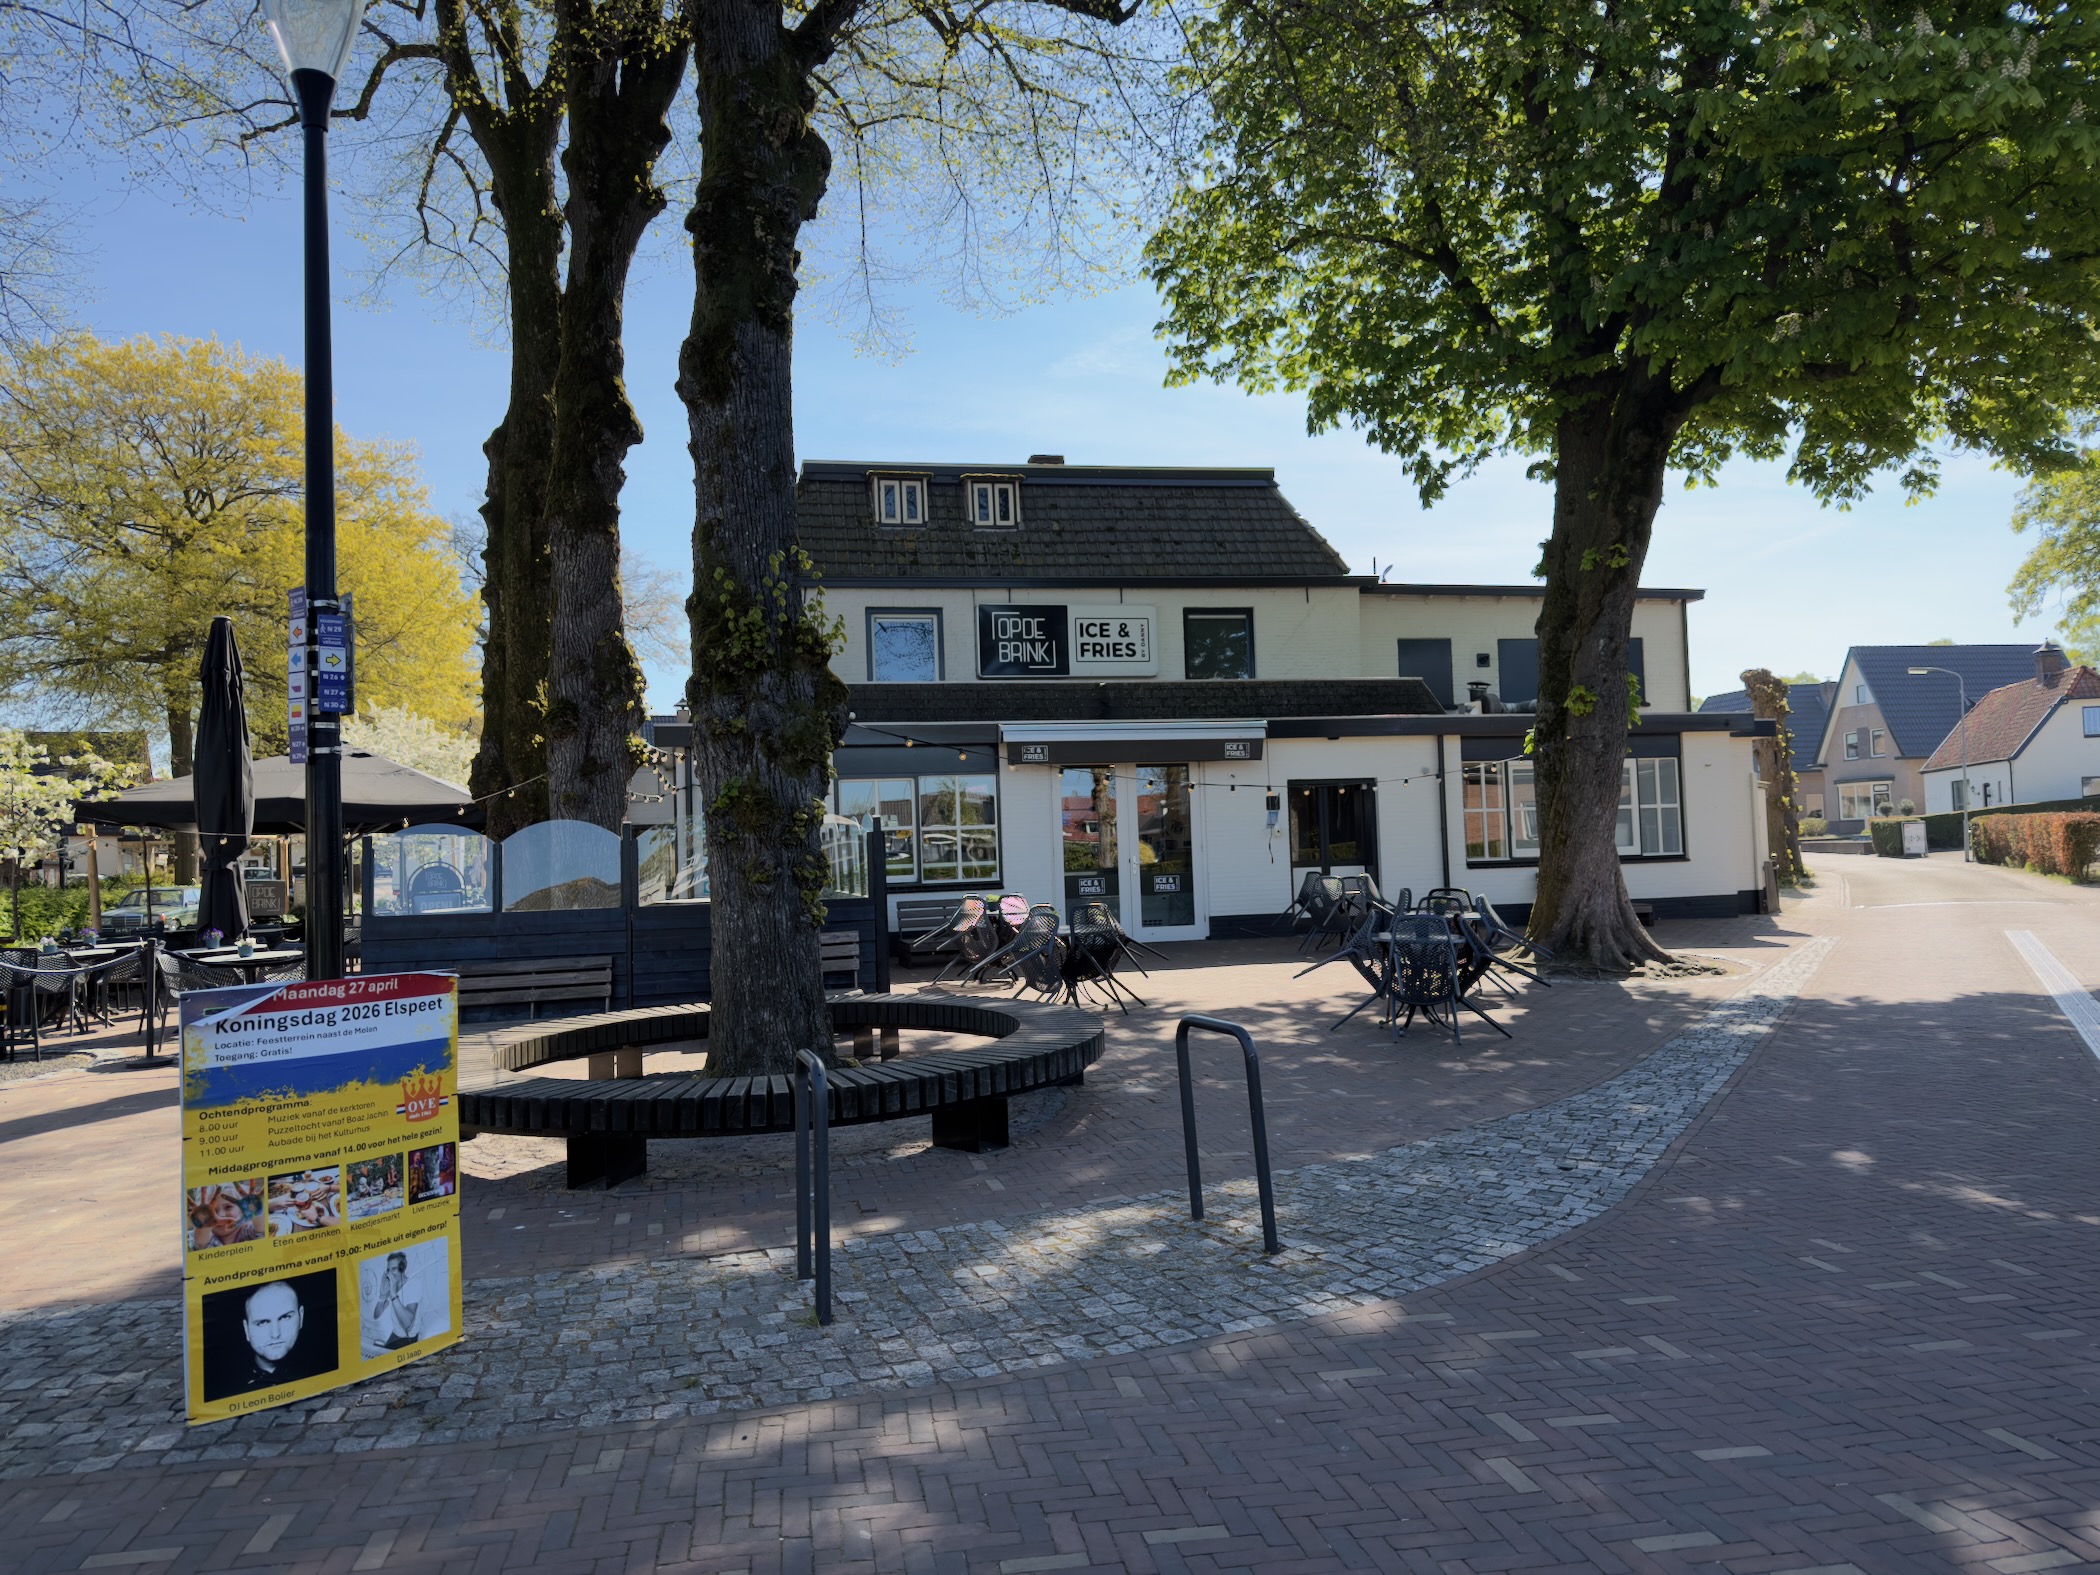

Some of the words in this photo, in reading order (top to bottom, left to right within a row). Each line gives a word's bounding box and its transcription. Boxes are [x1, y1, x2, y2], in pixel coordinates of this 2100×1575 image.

[1079, 622, 1111, 638] ICE
[1118, 622, 1130, 638] &
[999, 641, 1050, 662] BRINK
[1080, 642, 1137, 658] FRIES
[1141, 649, 1146, 658] BY
[251, 898, 277, 909] BRINK
[273, 983, 346, 1001] Maandag
[349, 981, 365, 995] 27
[368, 979, 398, 994] april
[215, 1009, 337, 1034] Koningsdag
[342, 1007, 381, 1022] 2026
[385, 997, 443, 1016] Elspeet
[215, 1039, 254, 1050] Locatie:
[257, 1033, 315, 1046] Feestterrein
[317, 1030, 341, 1039] naast
[343, 1028, 353, 1036] de
[354, 1025, 378, 1035] Molen
[215, 1053, 258, 1063] Toegang:
[260, 1047, 293, 1058] Gratis!
[199, 1099, 313, 1121] Ochtendprogramma:
[408, 1097, 437, 1113] OVE
[199, 1122, 221, 1133] 8.00
[222, 1121, 239, 1131] uur
[268, 1112, 300, 1124] Muziek
[302, 1108, 325, 1118] vanaf
[327, 1107, 337, 1116] de
[339, 1101, 376, 1114] kerktoren
[199, 1135, 221, 1145] 9.00
[222, 1133, 239, 1143] uur
[268, 1121, 323, 1136] Puzzeltocht
[324, 1118, 345, 1129] vanaf
[347, 1114, 365, 1125] Boaz
[366, 1109, 389, 1121] Jachin
[200, 1146, 227, 1158] 11.00
[228, 1144, 245, 1154] uur
[268, 1135, 304, 1148] Aubade
[305, 1132, 316, 1144] bij
[318, 1130, 332, 1141] het
[334, 1125, 371, 1140] Kulturhus
[208, 1152, 312, 1176] Middagprogramma
[313, 1147, 341, 1160] vanaf
[343, 1142, 367, 1155] 14.00
[367, 1139, 386, 1149] voor
[387, 1134, 400, 1146] het
[401, 1131, 419, 1143] hele
[420, 1126, 443, 1142] gezin!
[412, 1204, 426, 1214] Live
[427, 1198, 451, 1211] muziek
[350, 1212, 401, 1232] Kleedjesmarkt
[273, 1236, 294, 1248] Eten
[296, 1235, 308, 1244] en
[309, 1227, 341, 1242] drinken
[198, 1244, 254, 1262] Kinderplein
[203, 1259, 304, 1286] Avondprogramma
[305, 1252, 334, 1266] vanaf
[335, 1245, 362, 1260] 19.00:
[363, 1237, 392, 1253] Muziek
[393, 1232, 405, 1244] uit
[405, 1227, 426, 1243] eigen
[427, 1220, 448, 1237] dorp!
[397, 1353, 406, 1364] DJ
[406, 1348, 423, 1363] Jaap
[229, 1401, 241, 1412] DJ
[242, 1396, 267, 1410] Leon
[268, 1389, 296, 1404] Bolier
